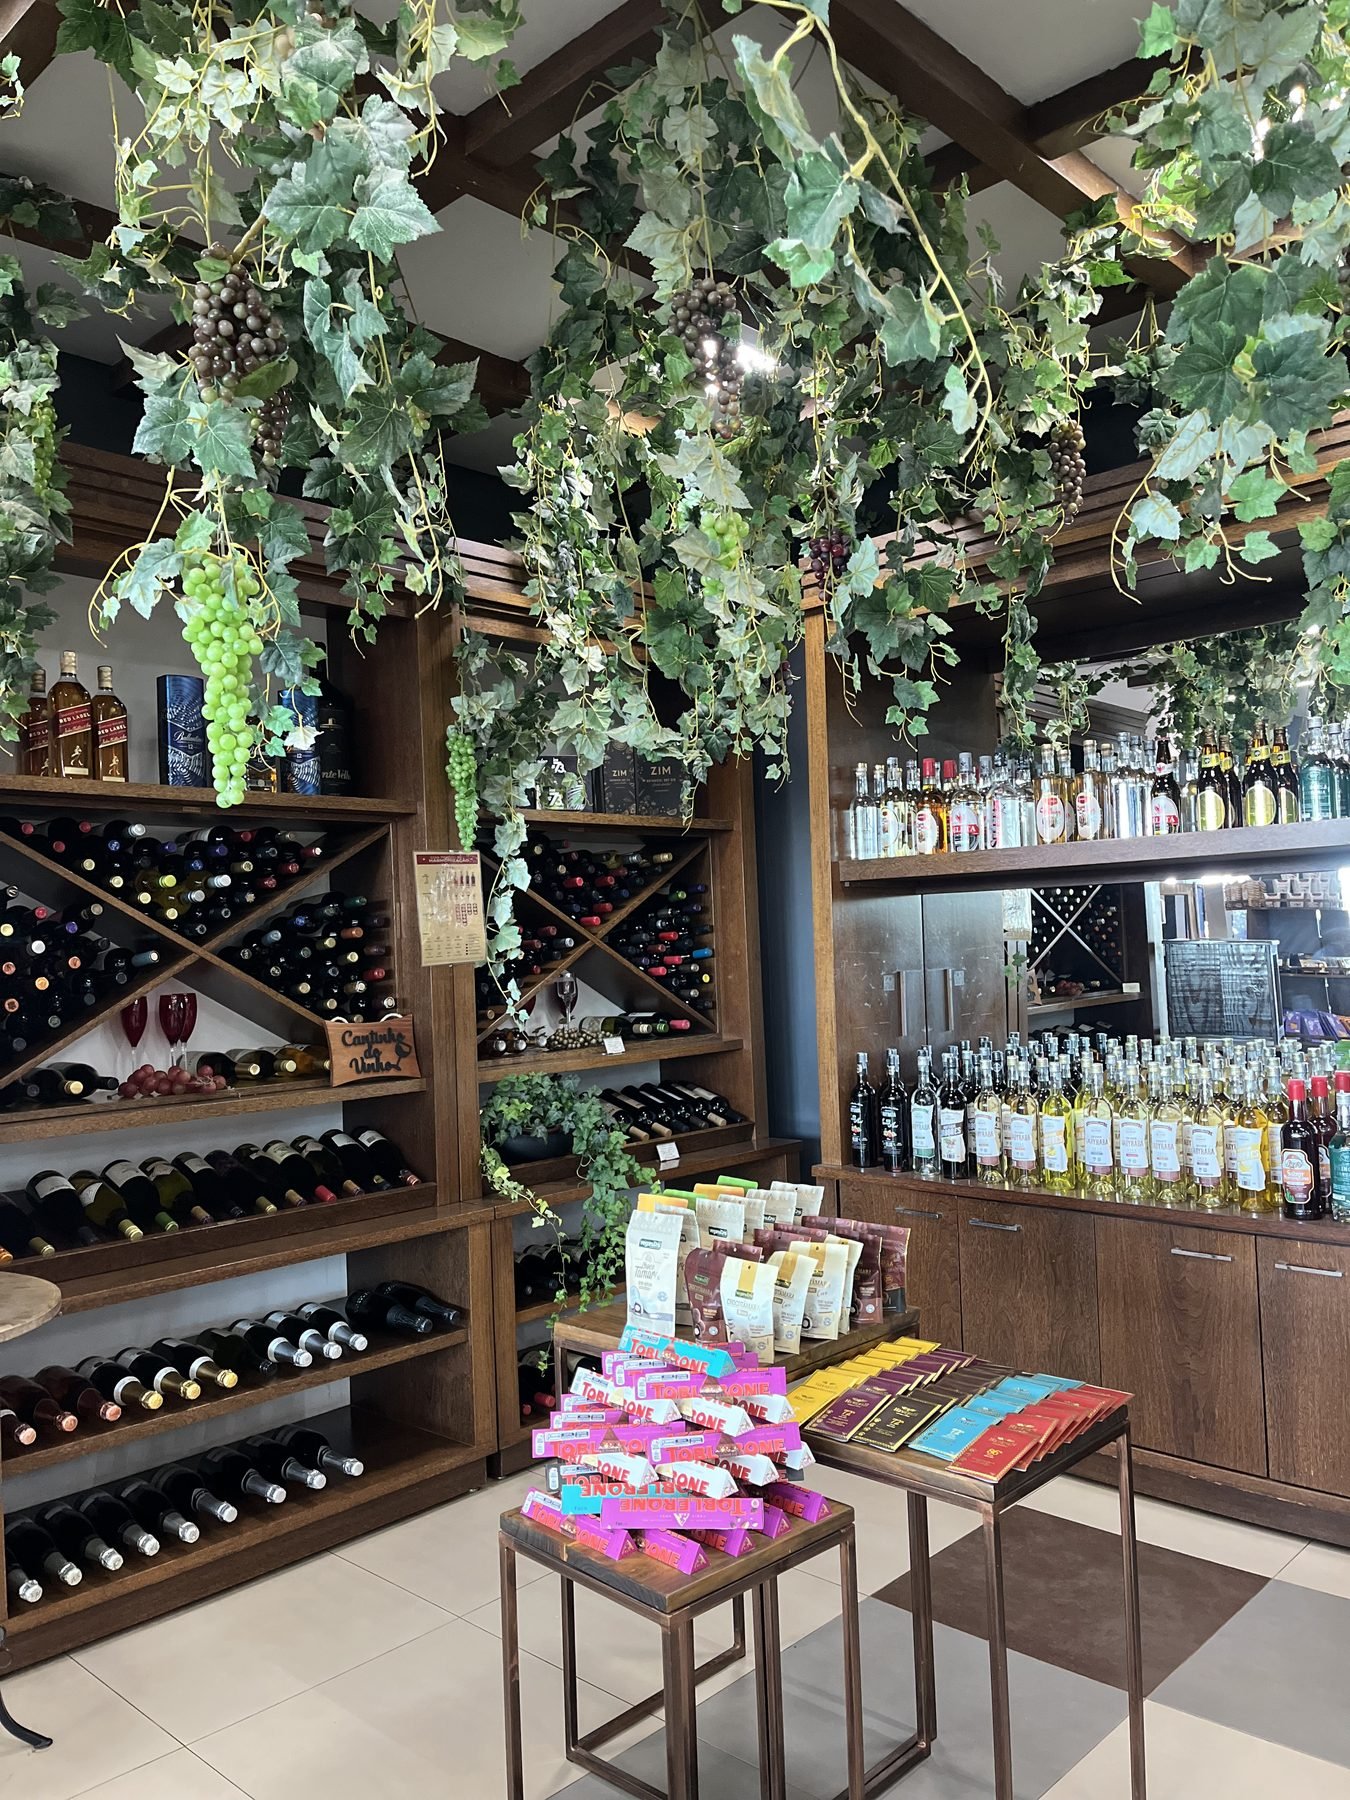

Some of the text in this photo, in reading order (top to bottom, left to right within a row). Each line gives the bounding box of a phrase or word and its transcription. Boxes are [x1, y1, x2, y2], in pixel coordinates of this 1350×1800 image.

[72, 713, 91, 721] LABEL
[612, 769, 628, 777] ZIM
[650, 766, 672, 776] ZIM
[341, 1027, 406, 1047] Cantinho
[349, 1056, 393, 1074] Vinho
[630, 1338, 709, 1374] TOBLRONE
[651, 1382, 770, 1400] TOBLRONE
[666, 1438, 786, 1462] TOBLRONE
[620, 1498, 747, 1517] TOBLERONE
[532, 1501, 609, 1552] TOBLRONE
